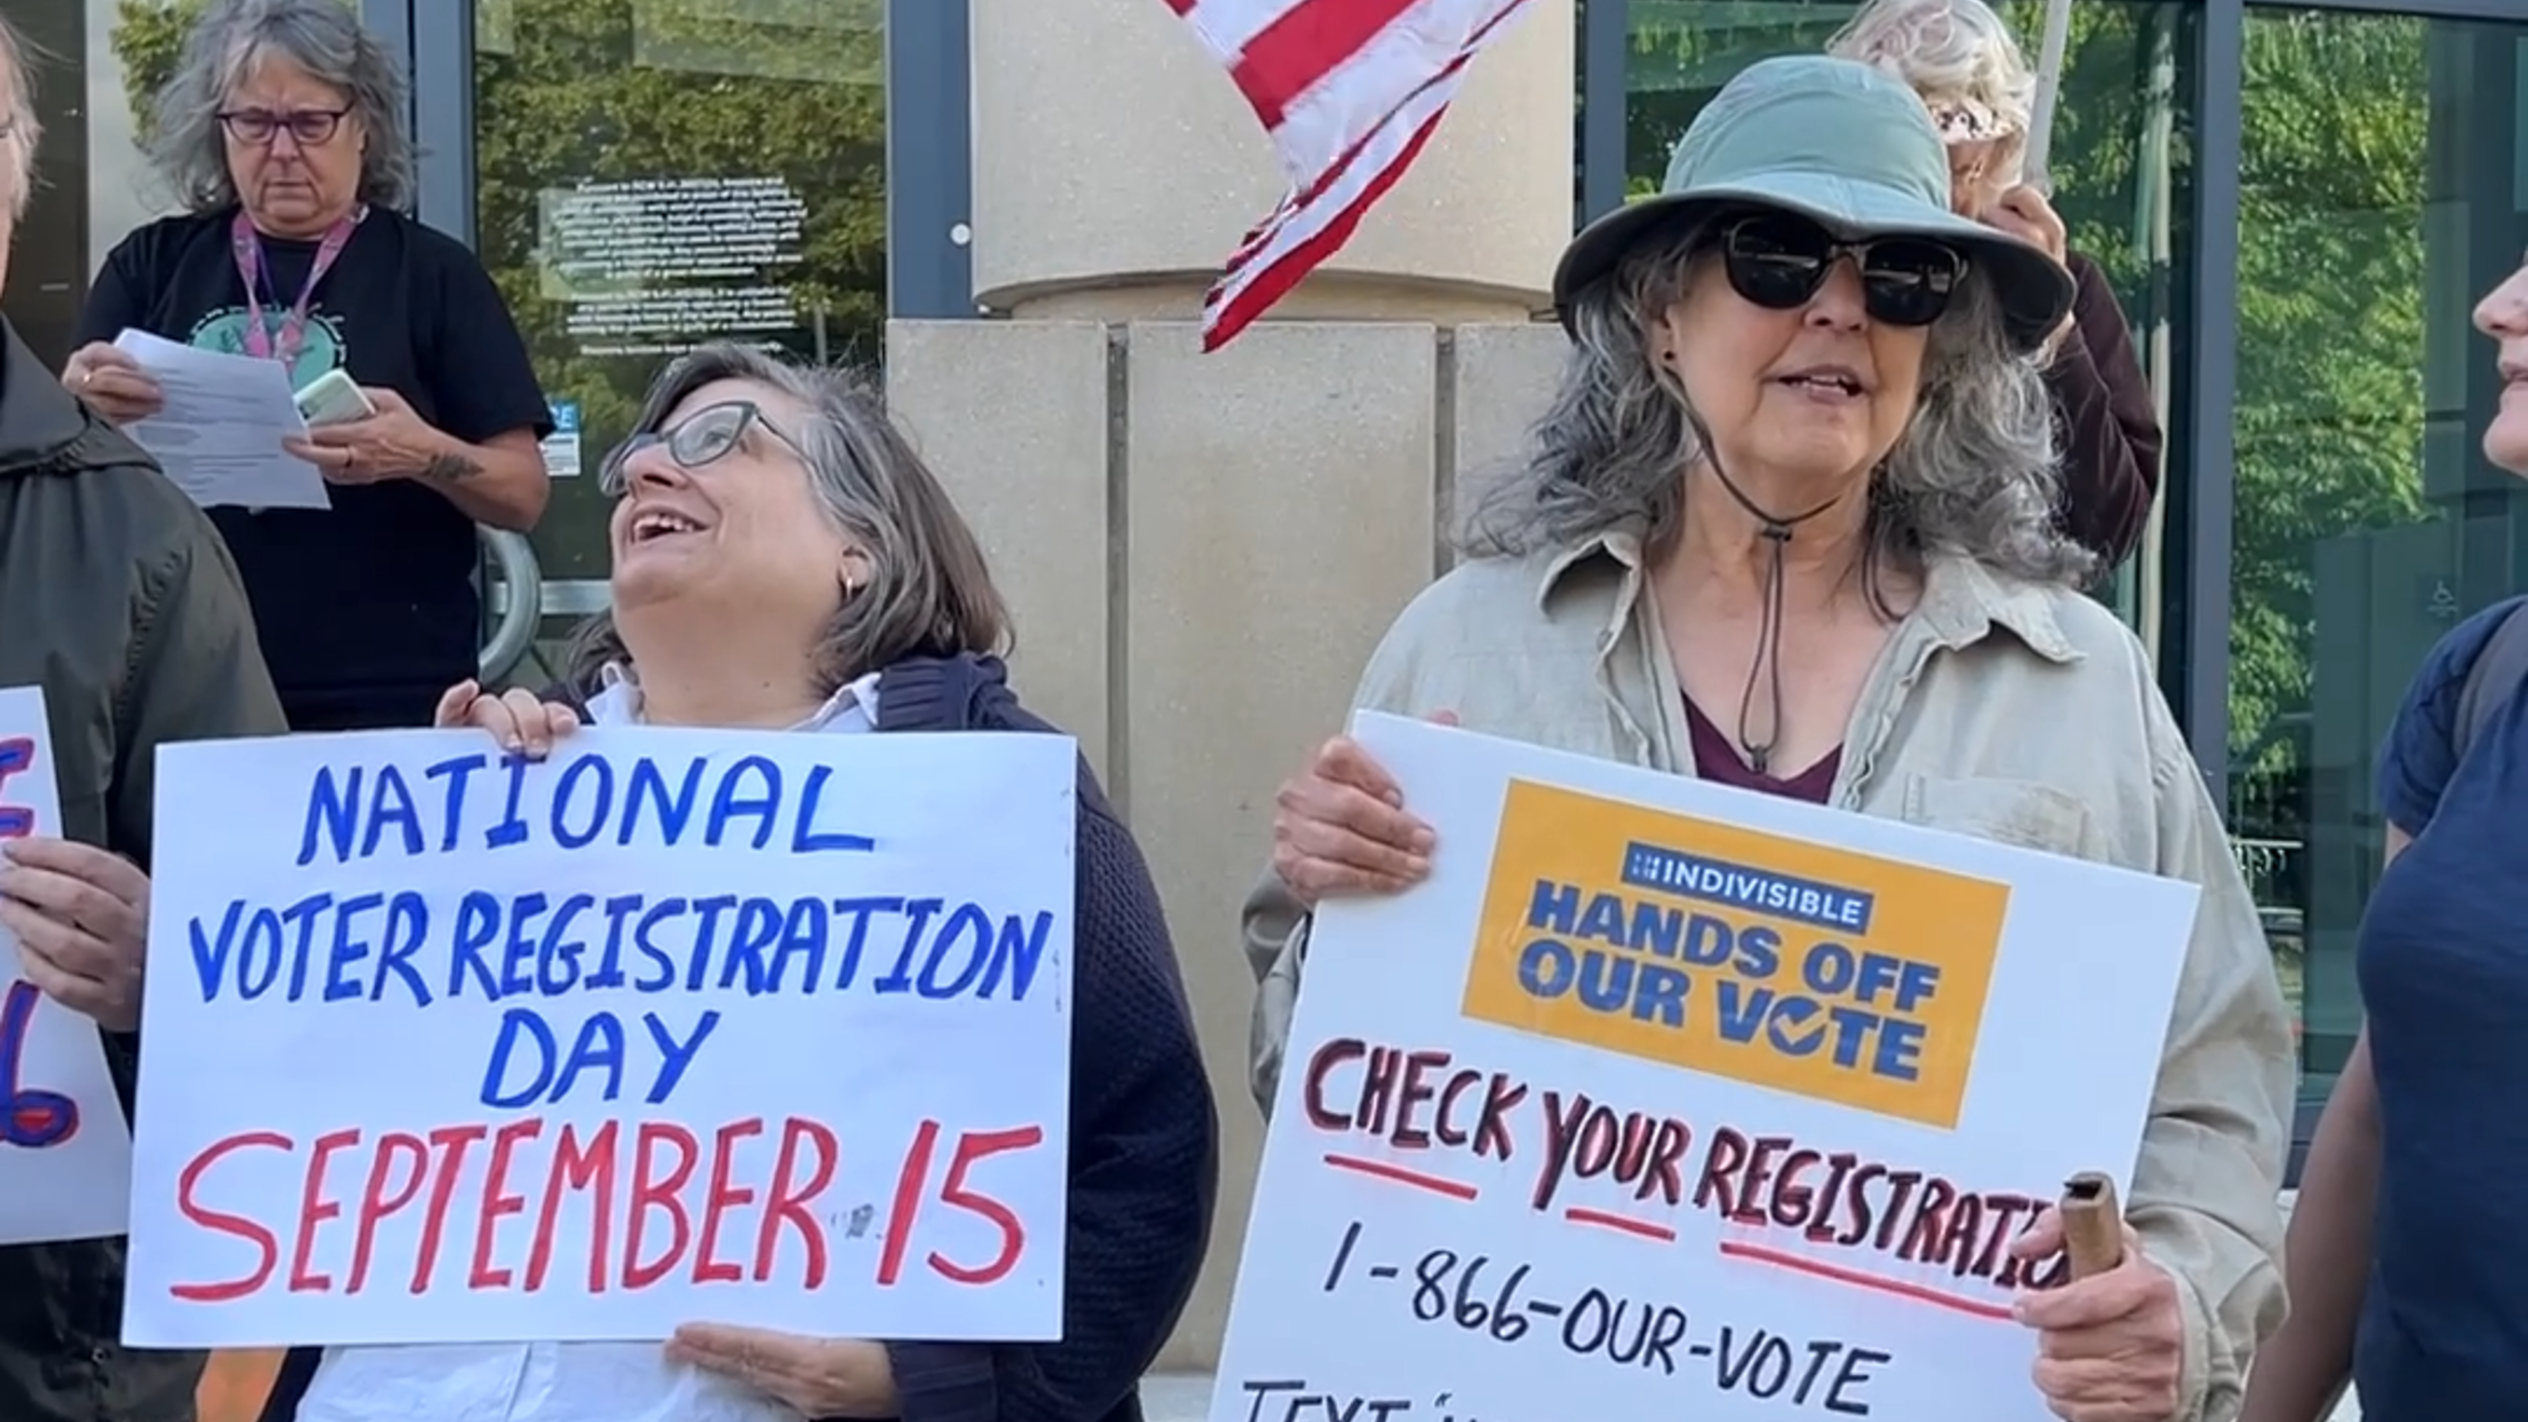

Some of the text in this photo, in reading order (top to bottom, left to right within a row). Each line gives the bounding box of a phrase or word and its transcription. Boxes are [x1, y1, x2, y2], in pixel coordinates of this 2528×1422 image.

[295, 752, 877, 867] NATIONAL
[188, 890, 1055, 1007] VOTER REGISTRATION
[1527, 878, 1941, 1013] HANDS OFF
[1661, 858, 1866, 926] INDIVISIBLE
[479, 1007, 721, 1110] DAY
[1517, 938, 1928, 1082] OUR VOTE
[1303, 1036, 1529, 1162] CHECK
[1533, 1091, 1692, 1211] YOUR
[169, 1118, 1043, 1302] SEPTEMBER 15
[1323, 1221, 1893, 1417] 1-866-OUR-VOTE
